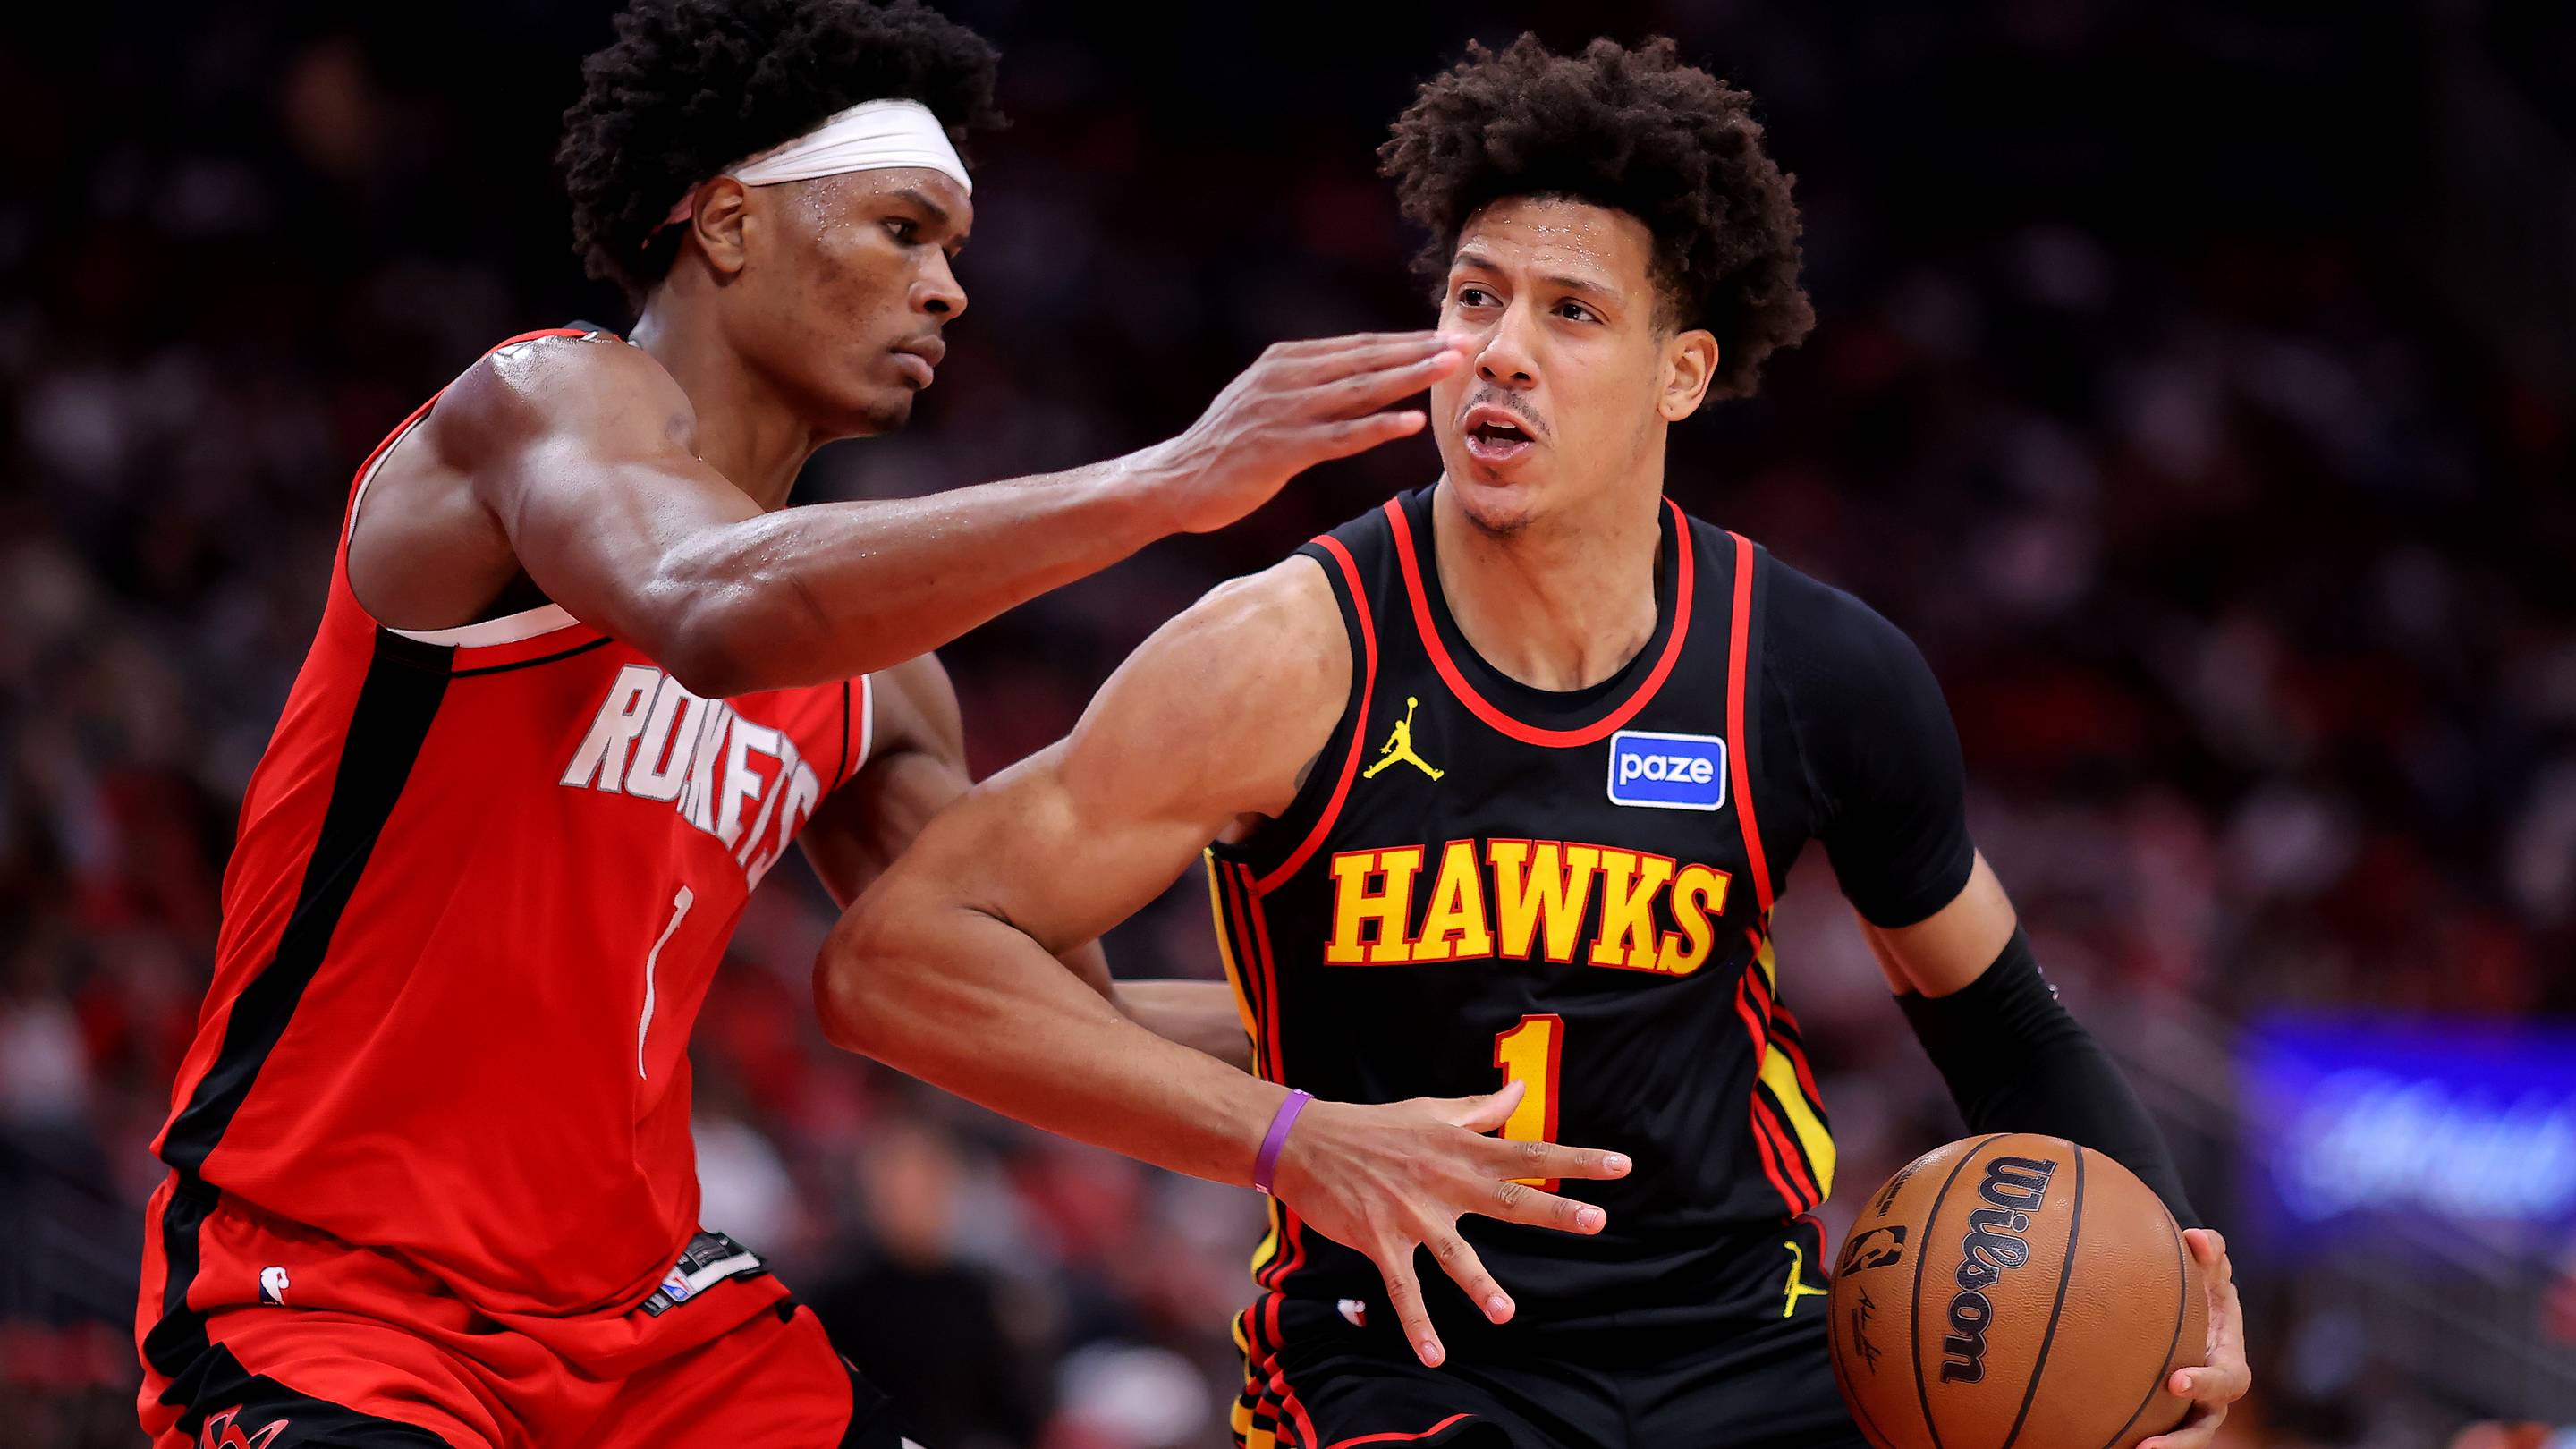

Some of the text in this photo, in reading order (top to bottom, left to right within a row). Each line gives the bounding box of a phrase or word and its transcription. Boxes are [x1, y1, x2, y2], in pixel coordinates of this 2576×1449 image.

[560, 663, 821, 894] ROKETS
[1618, 750, 1716, 786] paze
[638, 885, 694, 1080] 1
[1323, 837, 1733, 977] HAWKS
[1493, 1013, 1564, 1191] 1
[1939, 1155, 2058, 1384] Wilson
